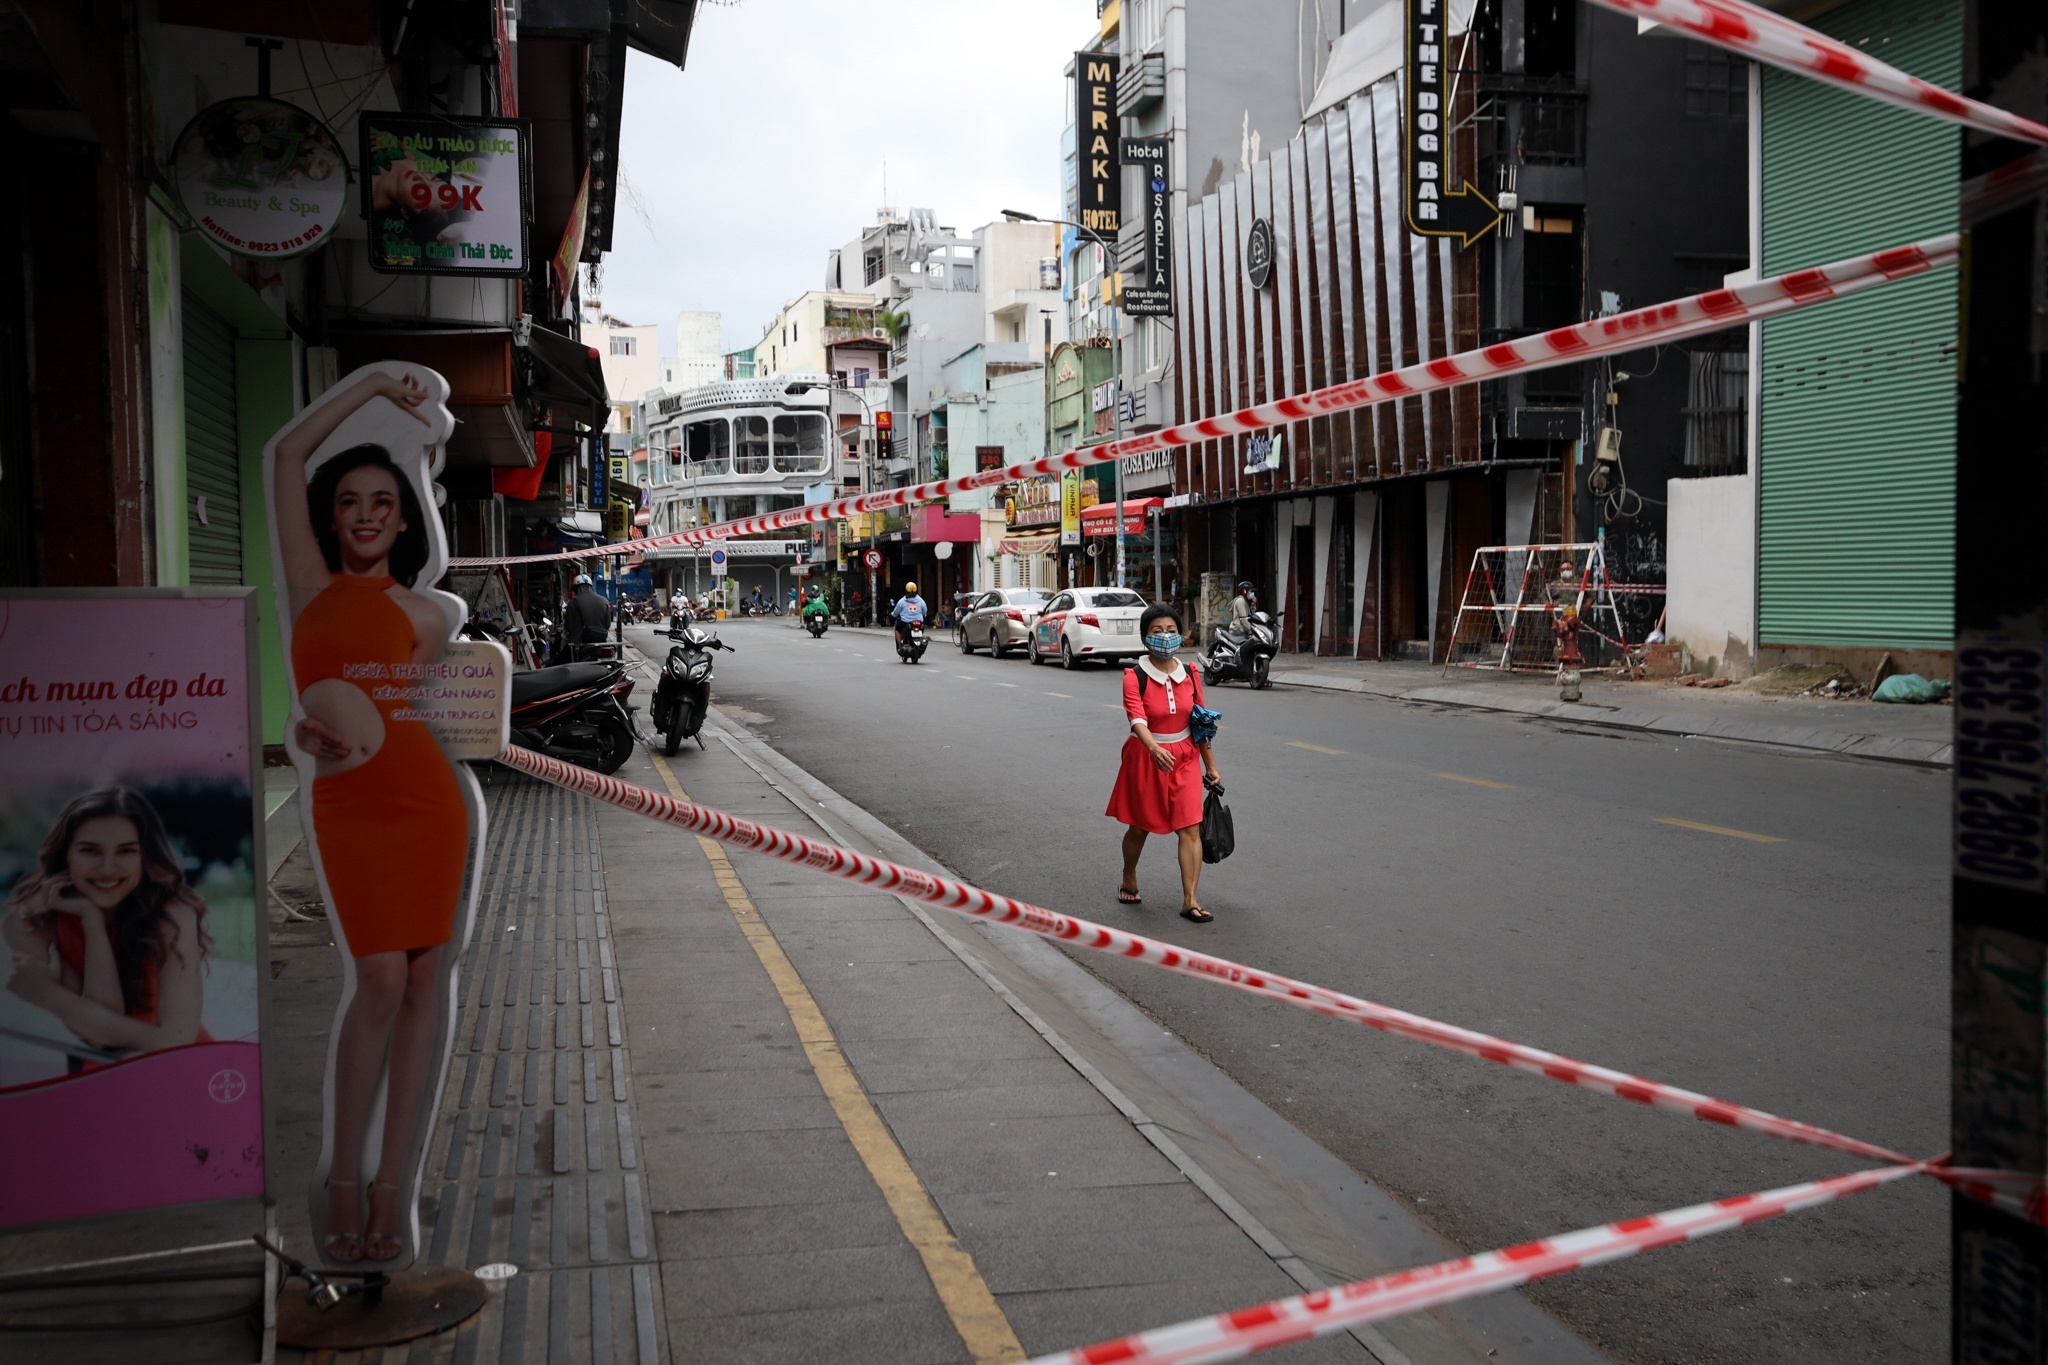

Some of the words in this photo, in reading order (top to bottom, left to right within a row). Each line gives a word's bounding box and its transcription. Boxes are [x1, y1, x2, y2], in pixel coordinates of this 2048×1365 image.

[1419, 24, 1438, 84] THE
[1088, 62, 1111, 204] MERAKI
[1418, 92, 1438, 152] DOG
[479, 138, 515, 156] DƯỢC
[1128, 145, 1163, 159] Hotel
[411, 183, 484, 212] 99K
[1418, 161, 1438, 220] BAR
[204, 192, 261, 211] Beauty
[268, 196, 282, 211] &
[289, 198, 320, 218] Spa
[1082, 209, 1118, 230] HOTEL
[202, 216, 245, 247] Hotline:
[248, 240, 278, 252] 0923
[282, 236, 303, 250] 919
[303, 223, 323, 241] 929
[489, 244, 513, 262] Độc
[981, 455, 1000, 466] BBQ
[392, 664, 424, 678] THAI
[426, 664, 458, 680] HIỆU
[462, 663, 495, 678] QUẢ
[0, 677, 40, 702] ch
[46, 680, 118, 706] mụn
[125, 673, 178, 706] đẹp
[186, 672, 228, 698] da
[30, 715, 64, 734] TIN
[72, 709, 123, 732] TỎA
[130, 708, 198, 731] SÁNG
